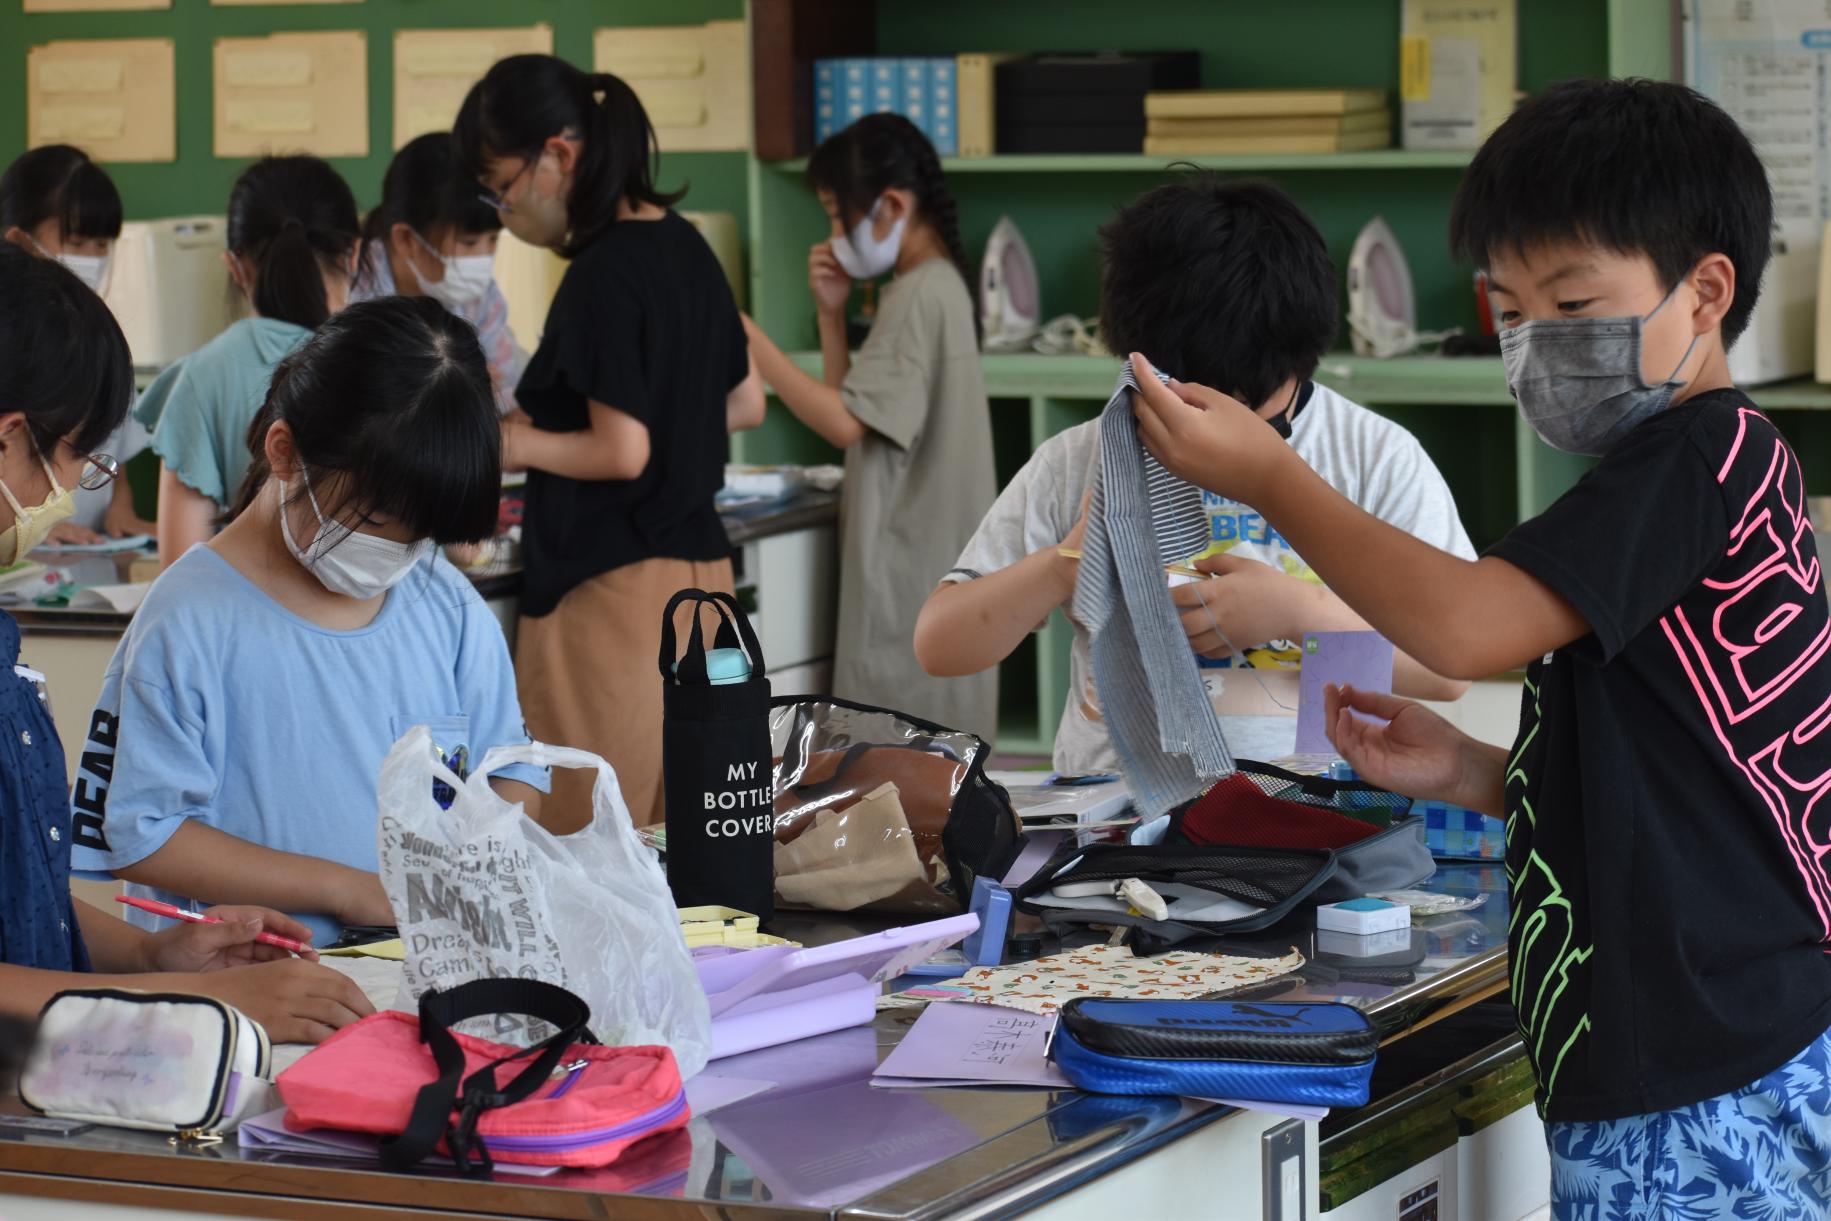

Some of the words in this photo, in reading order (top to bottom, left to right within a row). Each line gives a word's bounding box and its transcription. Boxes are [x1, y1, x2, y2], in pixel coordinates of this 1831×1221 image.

[727, 761, 757, 782] MY
[704, 786, 771, 810] BOTTLE
[705, 814, 772, 838] COVER
